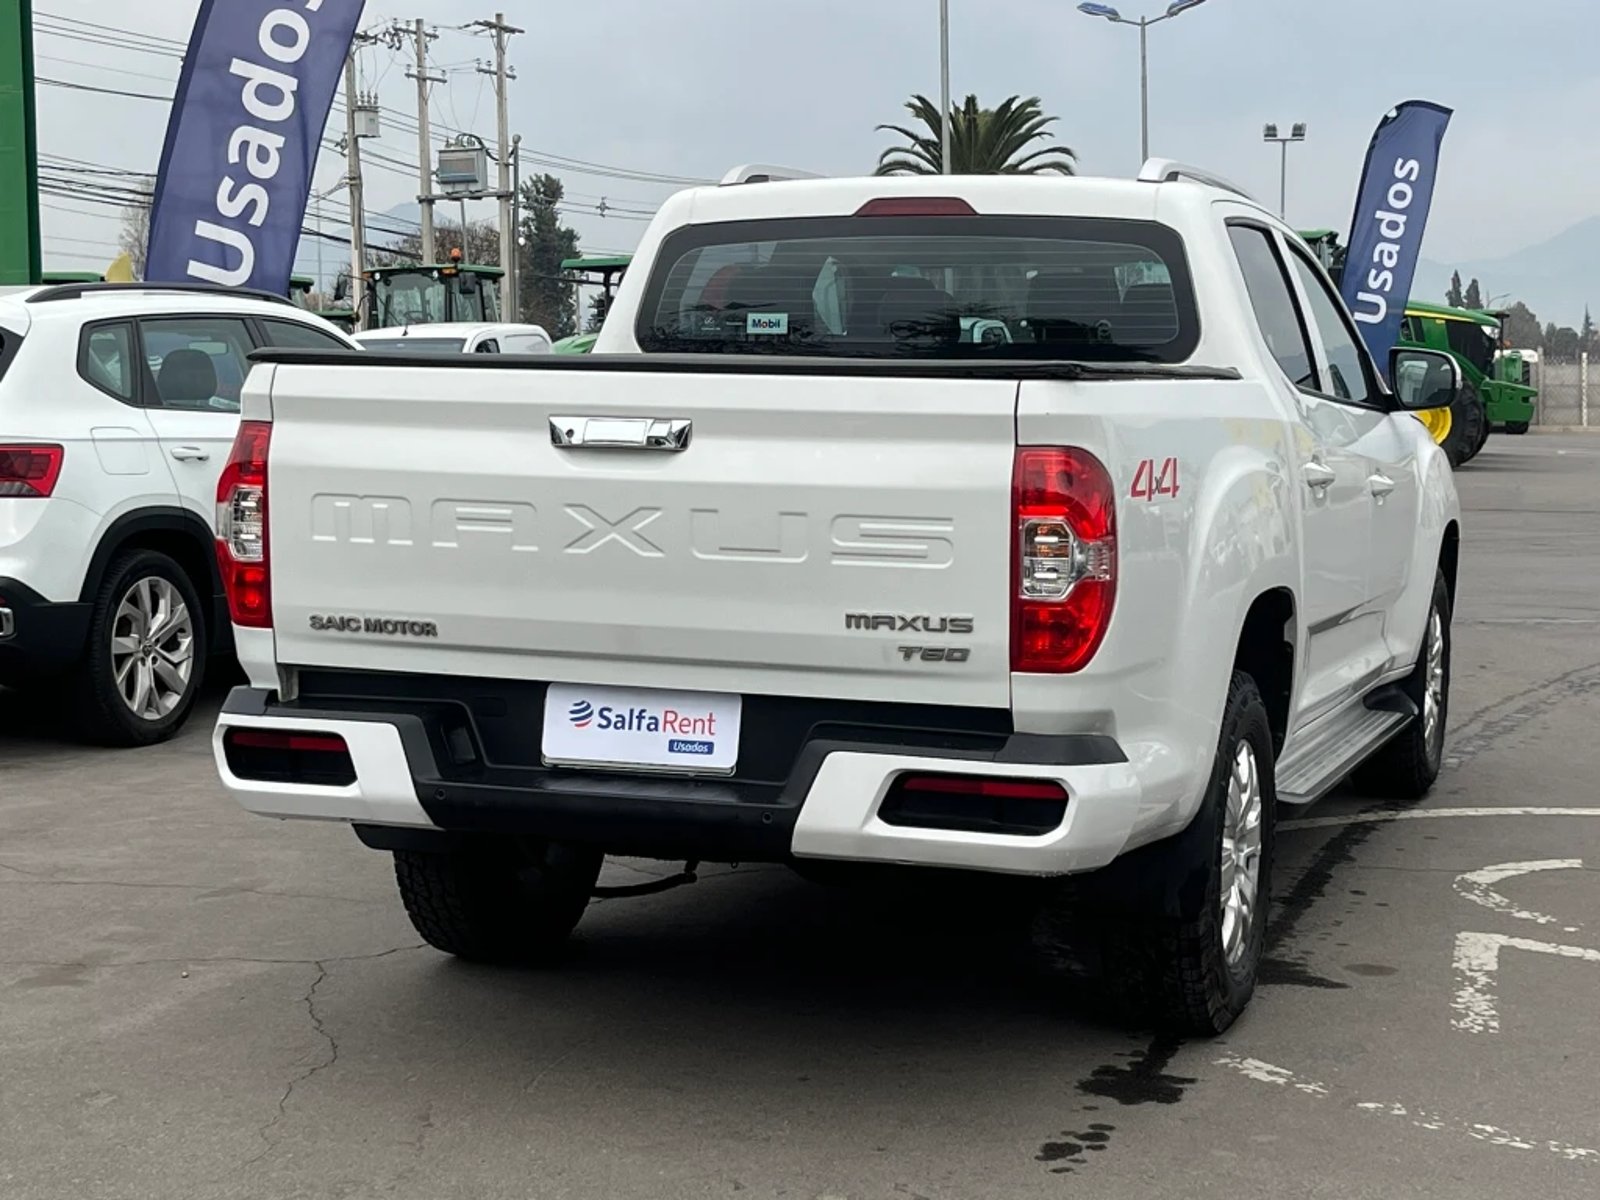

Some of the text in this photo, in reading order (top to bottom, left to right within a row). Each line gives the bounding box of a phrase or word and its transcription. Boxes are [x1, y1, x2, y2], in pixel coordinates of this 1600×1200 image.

[187, 0, 325, 287] Usado
[1353, 157, 1420, 325] Usados
[752, 319, 781, 329] Mobil
[1131, 457, 1180, 502] 4x4
[311, 492, 955, 570] MAXUS
[308, 615, 438, 637] SAIC MOTOR
[845, 613, 975, 634] MAXUS
[898, 646, 972, 663] T60
[673, 741, 709, 754] Usados
